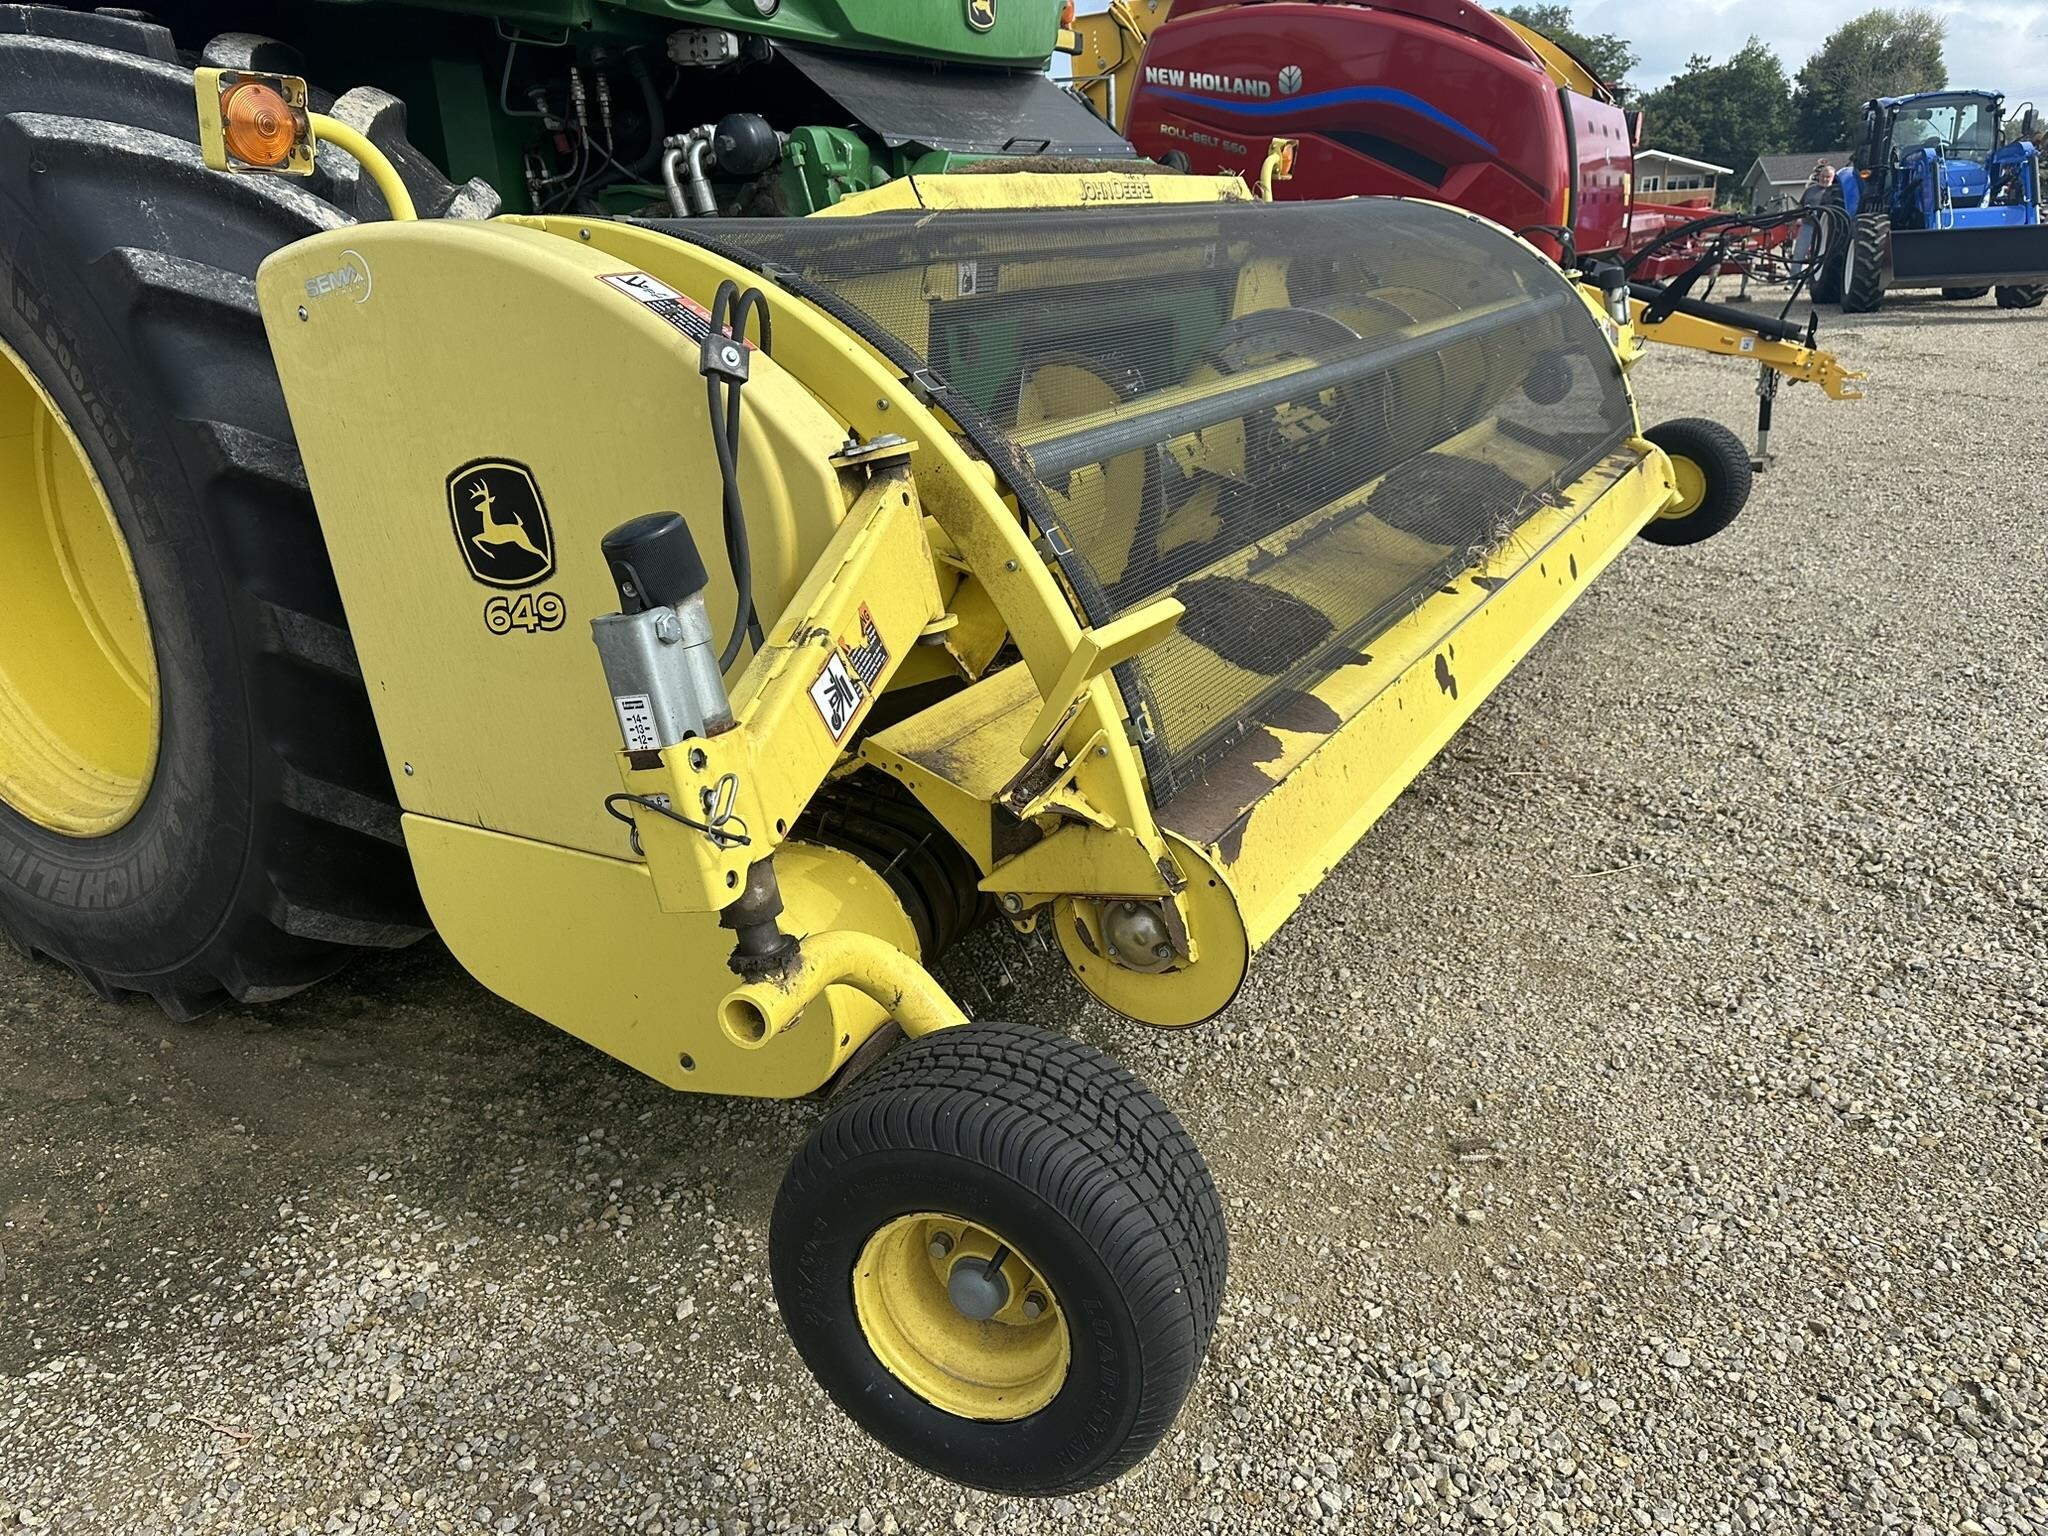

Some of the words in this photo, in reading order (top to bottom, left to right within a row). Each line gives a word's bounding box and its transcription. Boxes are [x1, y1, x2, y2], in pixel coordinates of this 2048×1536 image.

[1145, 66, 1185, 87] NEW
[1189, 71, 1271, 98] HOLLAND
[1159, 124, 1220, 147] ROLL-BELT
[44, 322, 119, 449] 900/60
[484, 591, 567, 636] 649
